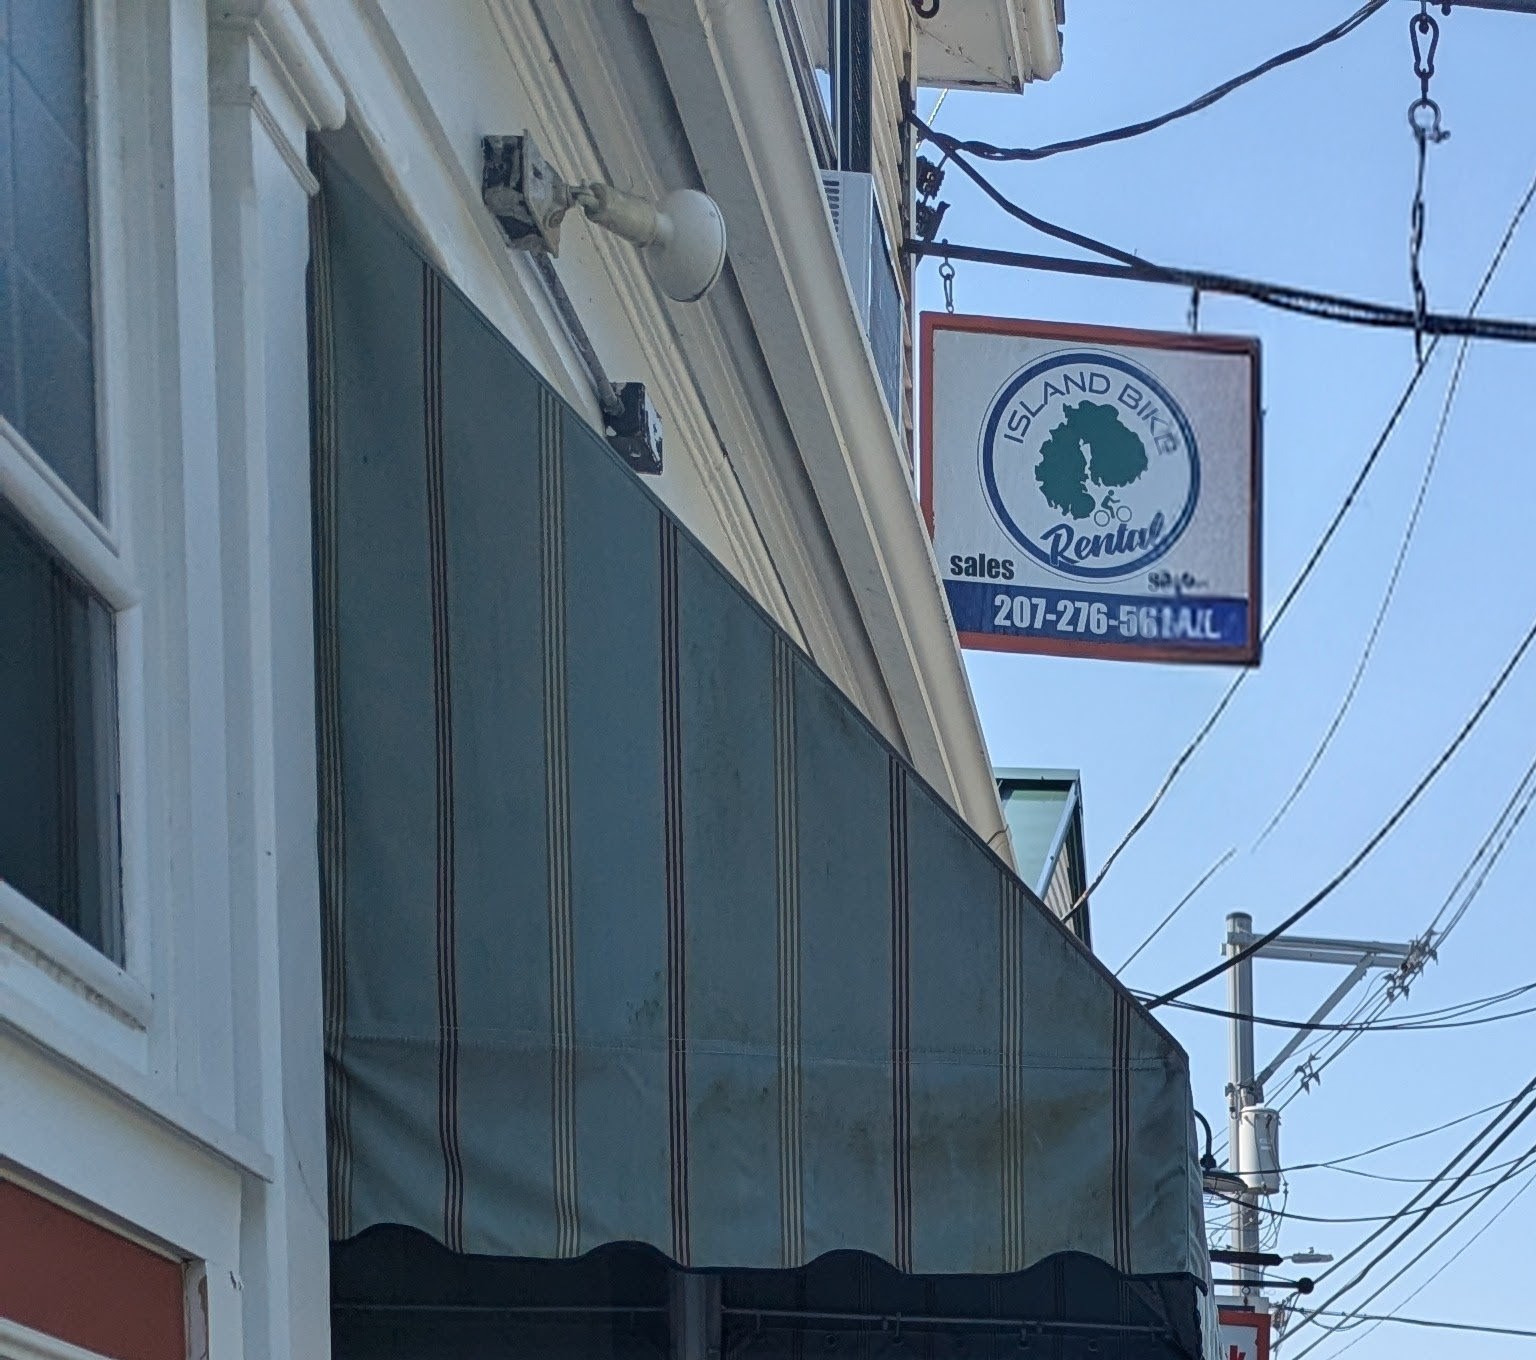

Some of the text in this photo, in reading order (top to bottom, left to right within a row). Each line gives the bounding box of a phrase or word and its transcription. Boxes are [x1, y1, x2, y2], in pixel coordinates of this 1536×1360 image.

[1004, 371, 1178, 457] ISLAND BIKE
[1040, 512, 1166, 566] Rental
[950, 553, 1014, 580] sales
